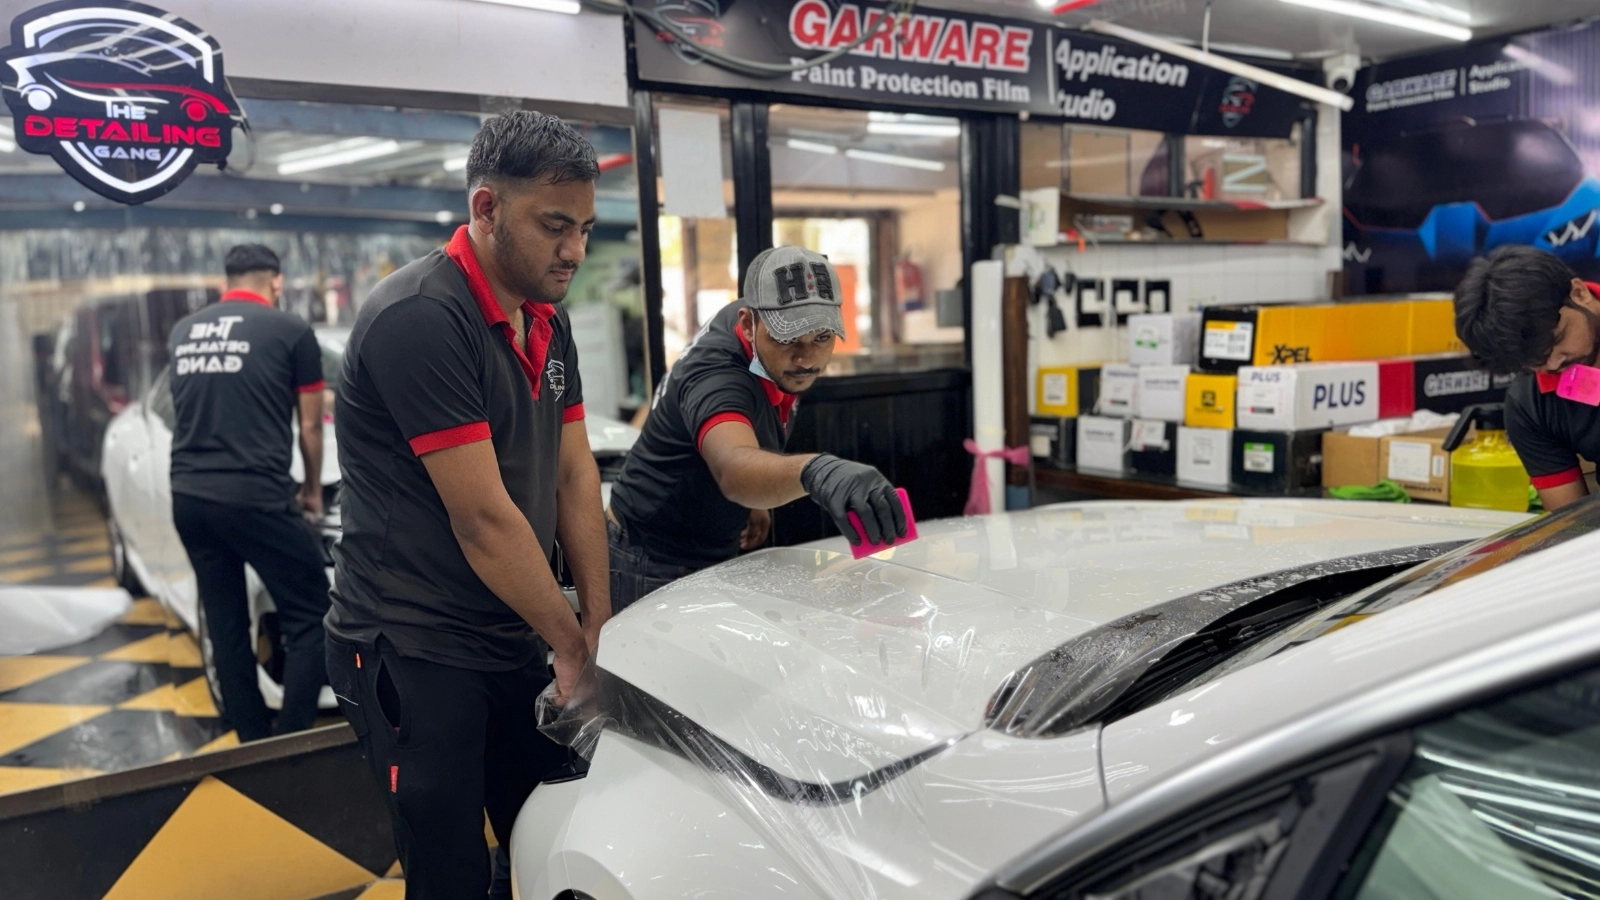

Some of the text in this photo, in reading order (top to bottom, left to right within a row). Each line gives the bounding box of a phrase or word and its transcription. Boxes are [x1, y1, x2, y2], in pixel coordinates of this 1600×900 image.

[788, 0, 1033, 73] GARWARE
[1055, 38, 1189, 88] Application
[790, 56, 1031, 103] Paint Protection Film
[105, 100, 147, 120] THE
[1057, 88, 1117, 121] tudio
[24, 115, 221, 147] DETAILING
[94, 145, 162, 161] GANG
[1271, 344, 1312, 365] XPEL
[1251, 371, 1281, 383] PLUS
[1312, 379, 1366, 411] PLUS
